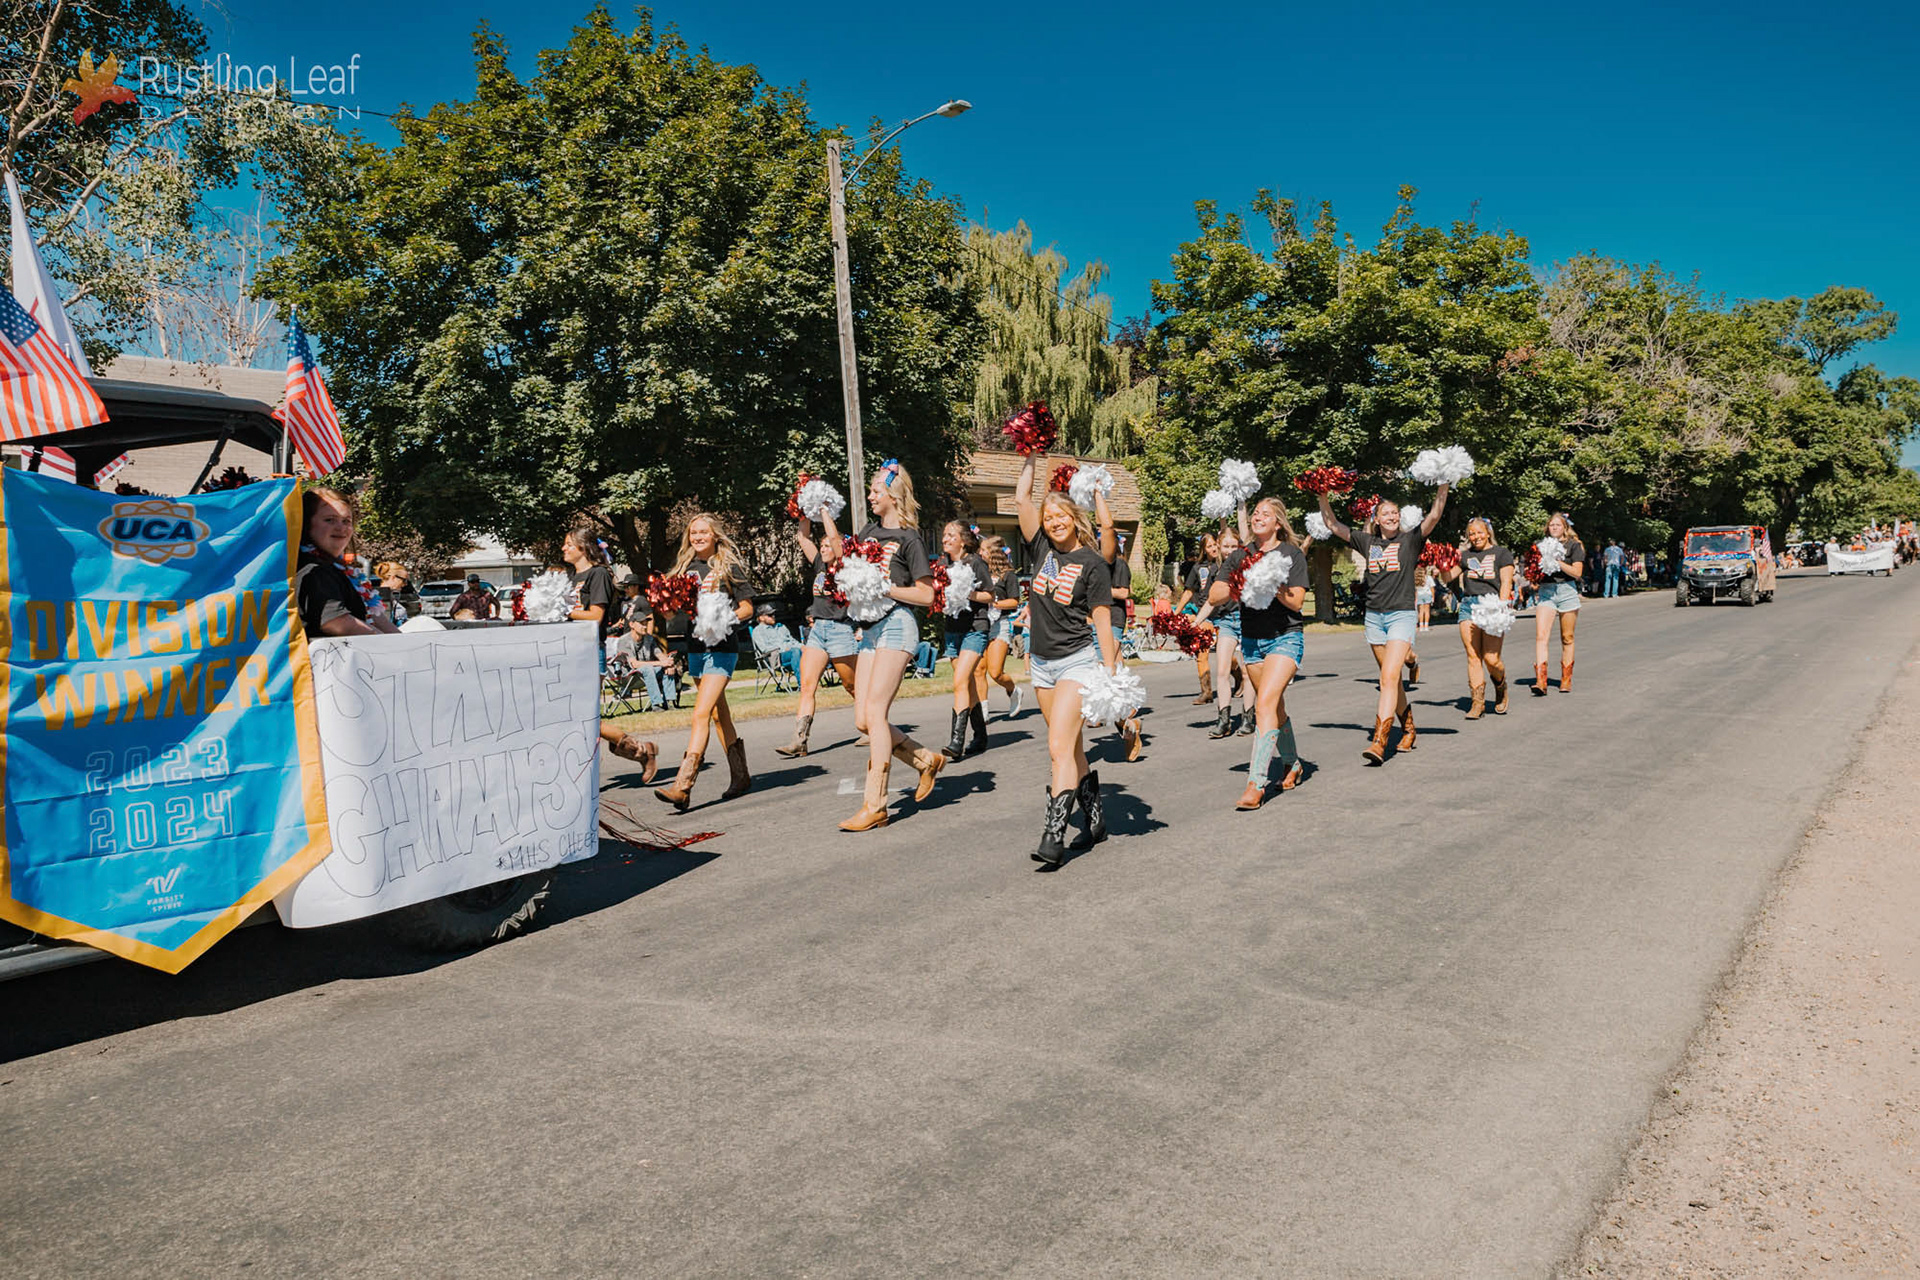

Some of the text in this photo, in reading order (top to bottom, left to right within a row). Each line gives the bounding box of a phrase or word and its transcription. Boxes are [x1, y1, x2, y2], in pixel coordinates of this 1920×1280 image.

[112, 518, 195, 541] UCA
[26, 589, 272, 660] DIVISION
[36, 654, 271, 730] WINNER
[315, 637, 574, 767] STATE
[86, 736, 229, 798] 2023
[89, 789, 233, 857] 2024
[559, 831, 598, 858] CHEER
